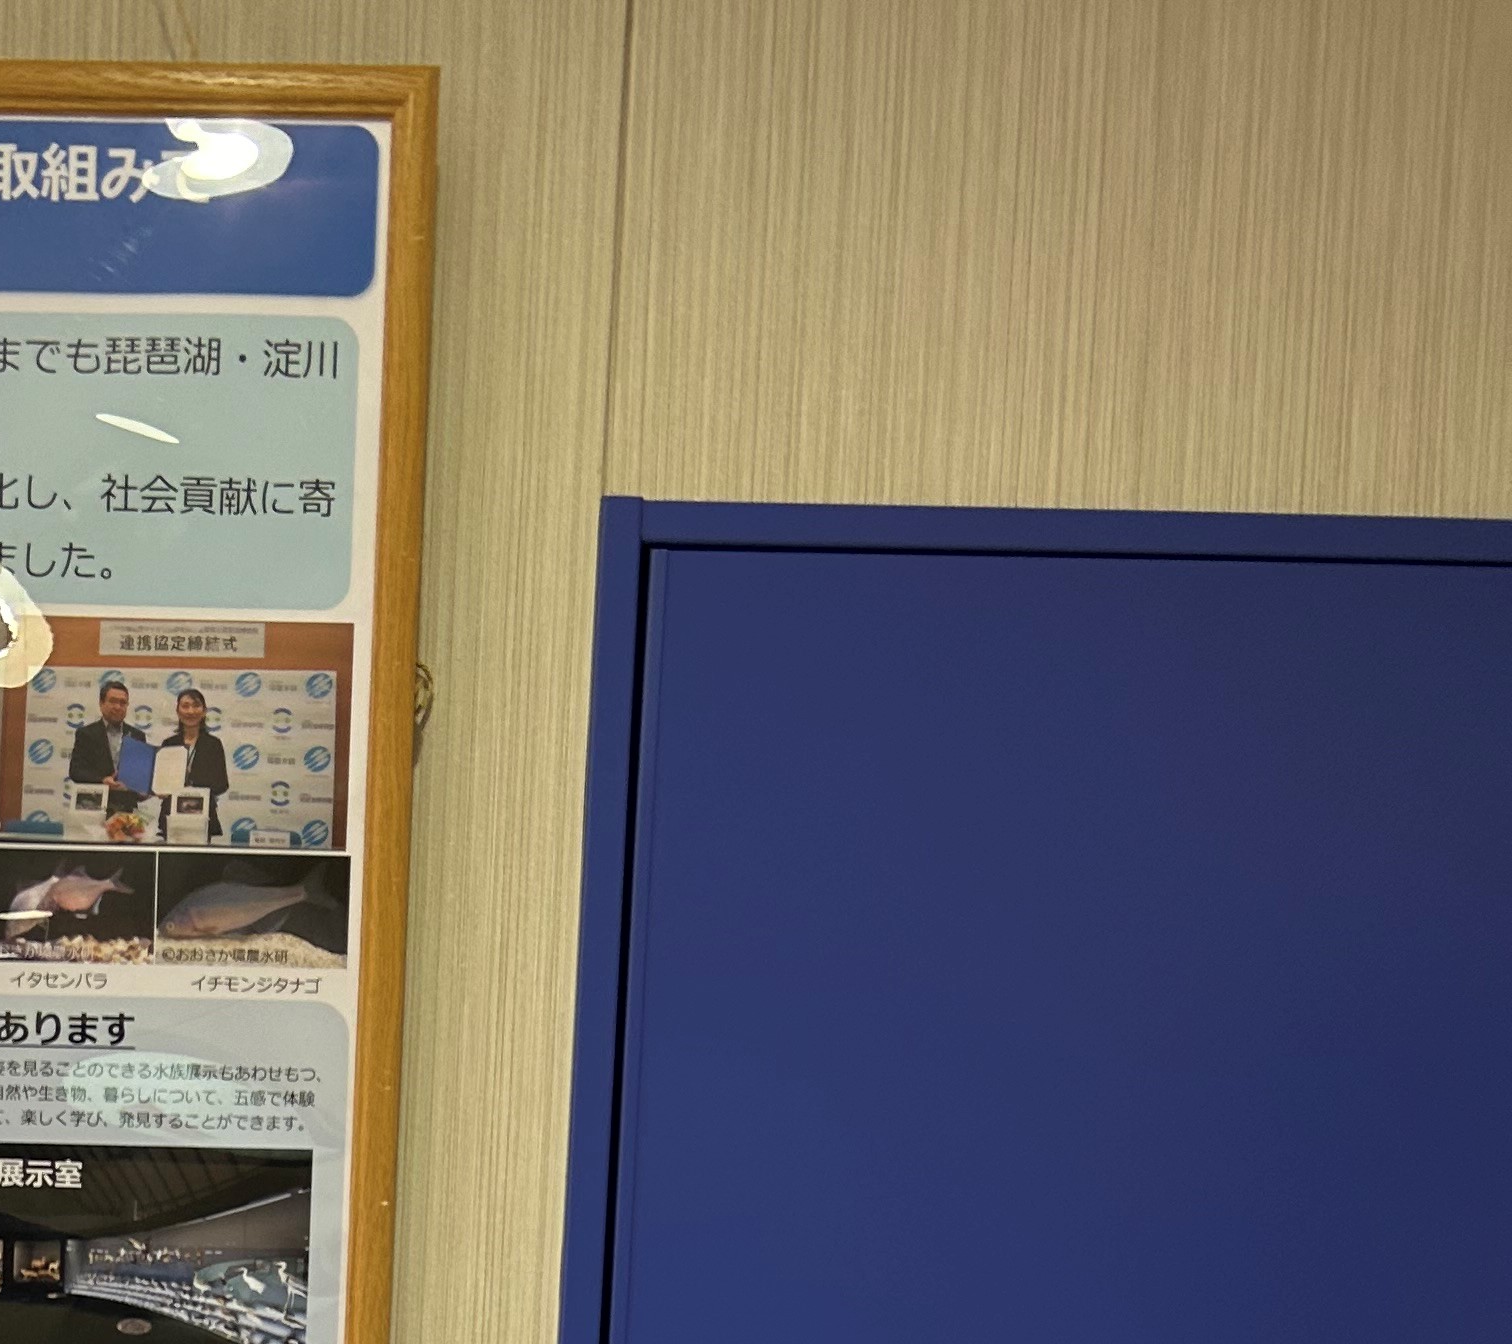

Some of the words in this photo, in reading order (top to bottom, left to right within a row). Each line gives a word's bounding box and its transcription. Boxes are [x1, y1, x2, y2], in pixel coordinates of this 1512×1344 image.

[10, 971, 108, 990] イタセンパラ
[191, 976, 322, 995] イチモンジタナゴ
